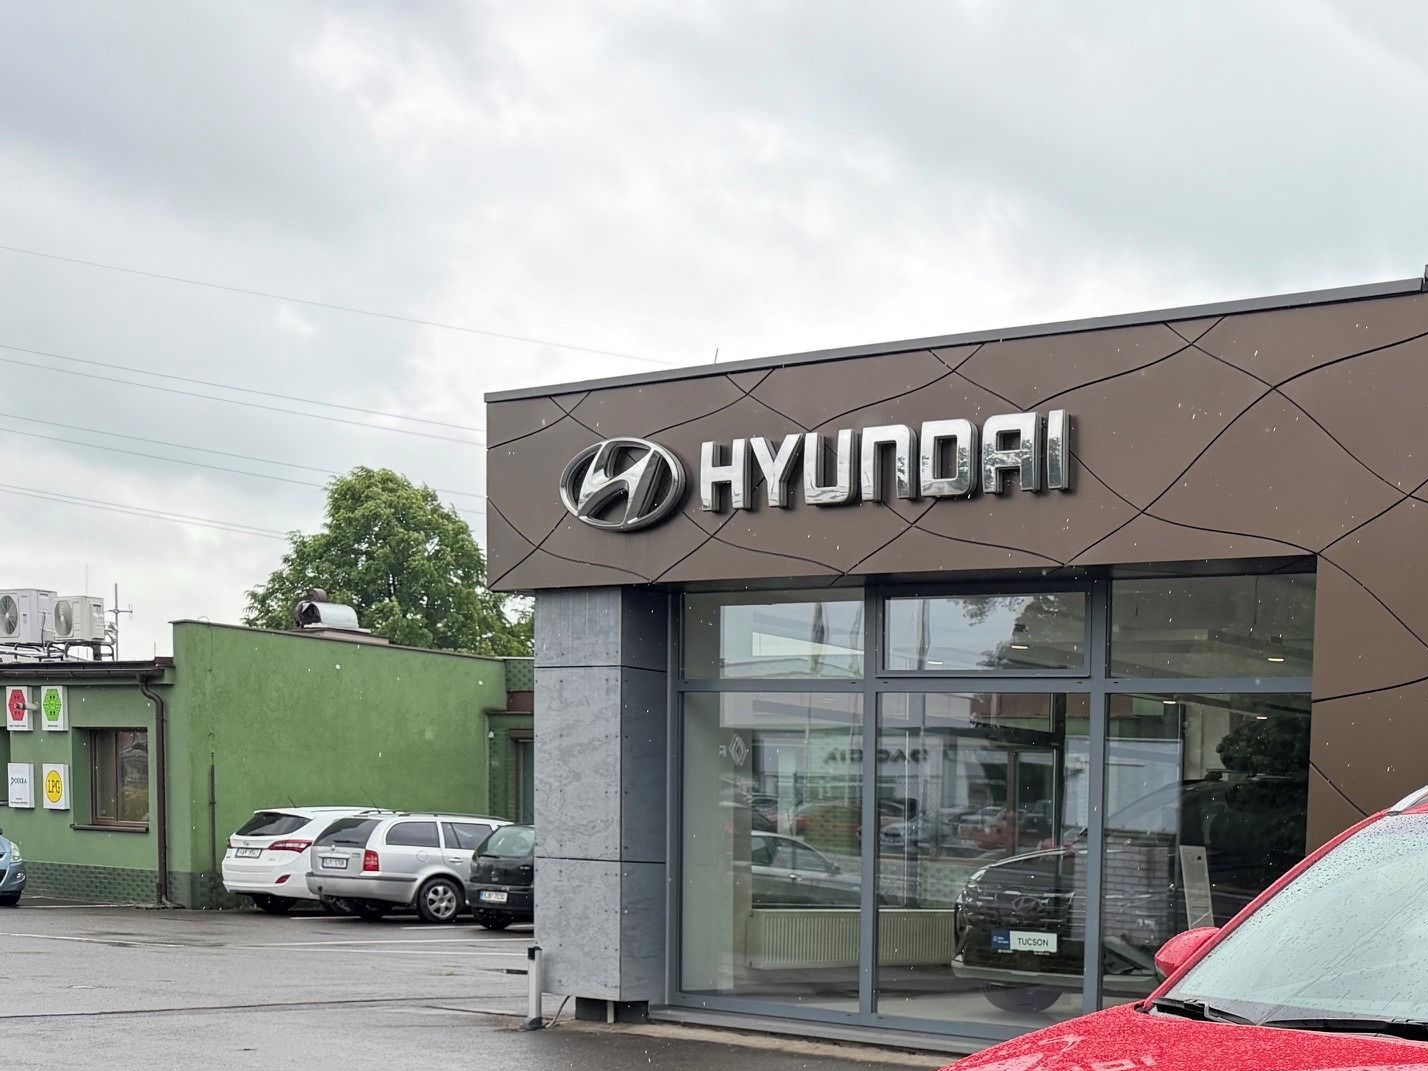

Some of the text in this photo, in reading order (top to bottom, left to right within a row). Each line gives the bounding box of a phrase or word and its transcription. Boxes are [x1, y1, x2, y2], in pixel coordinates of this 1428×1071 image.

[700, 408, 1075, 513] HYUNDAI
[48, 779, 60, 794] LPG
[1017, 937, 1049, 947] TUCSON
